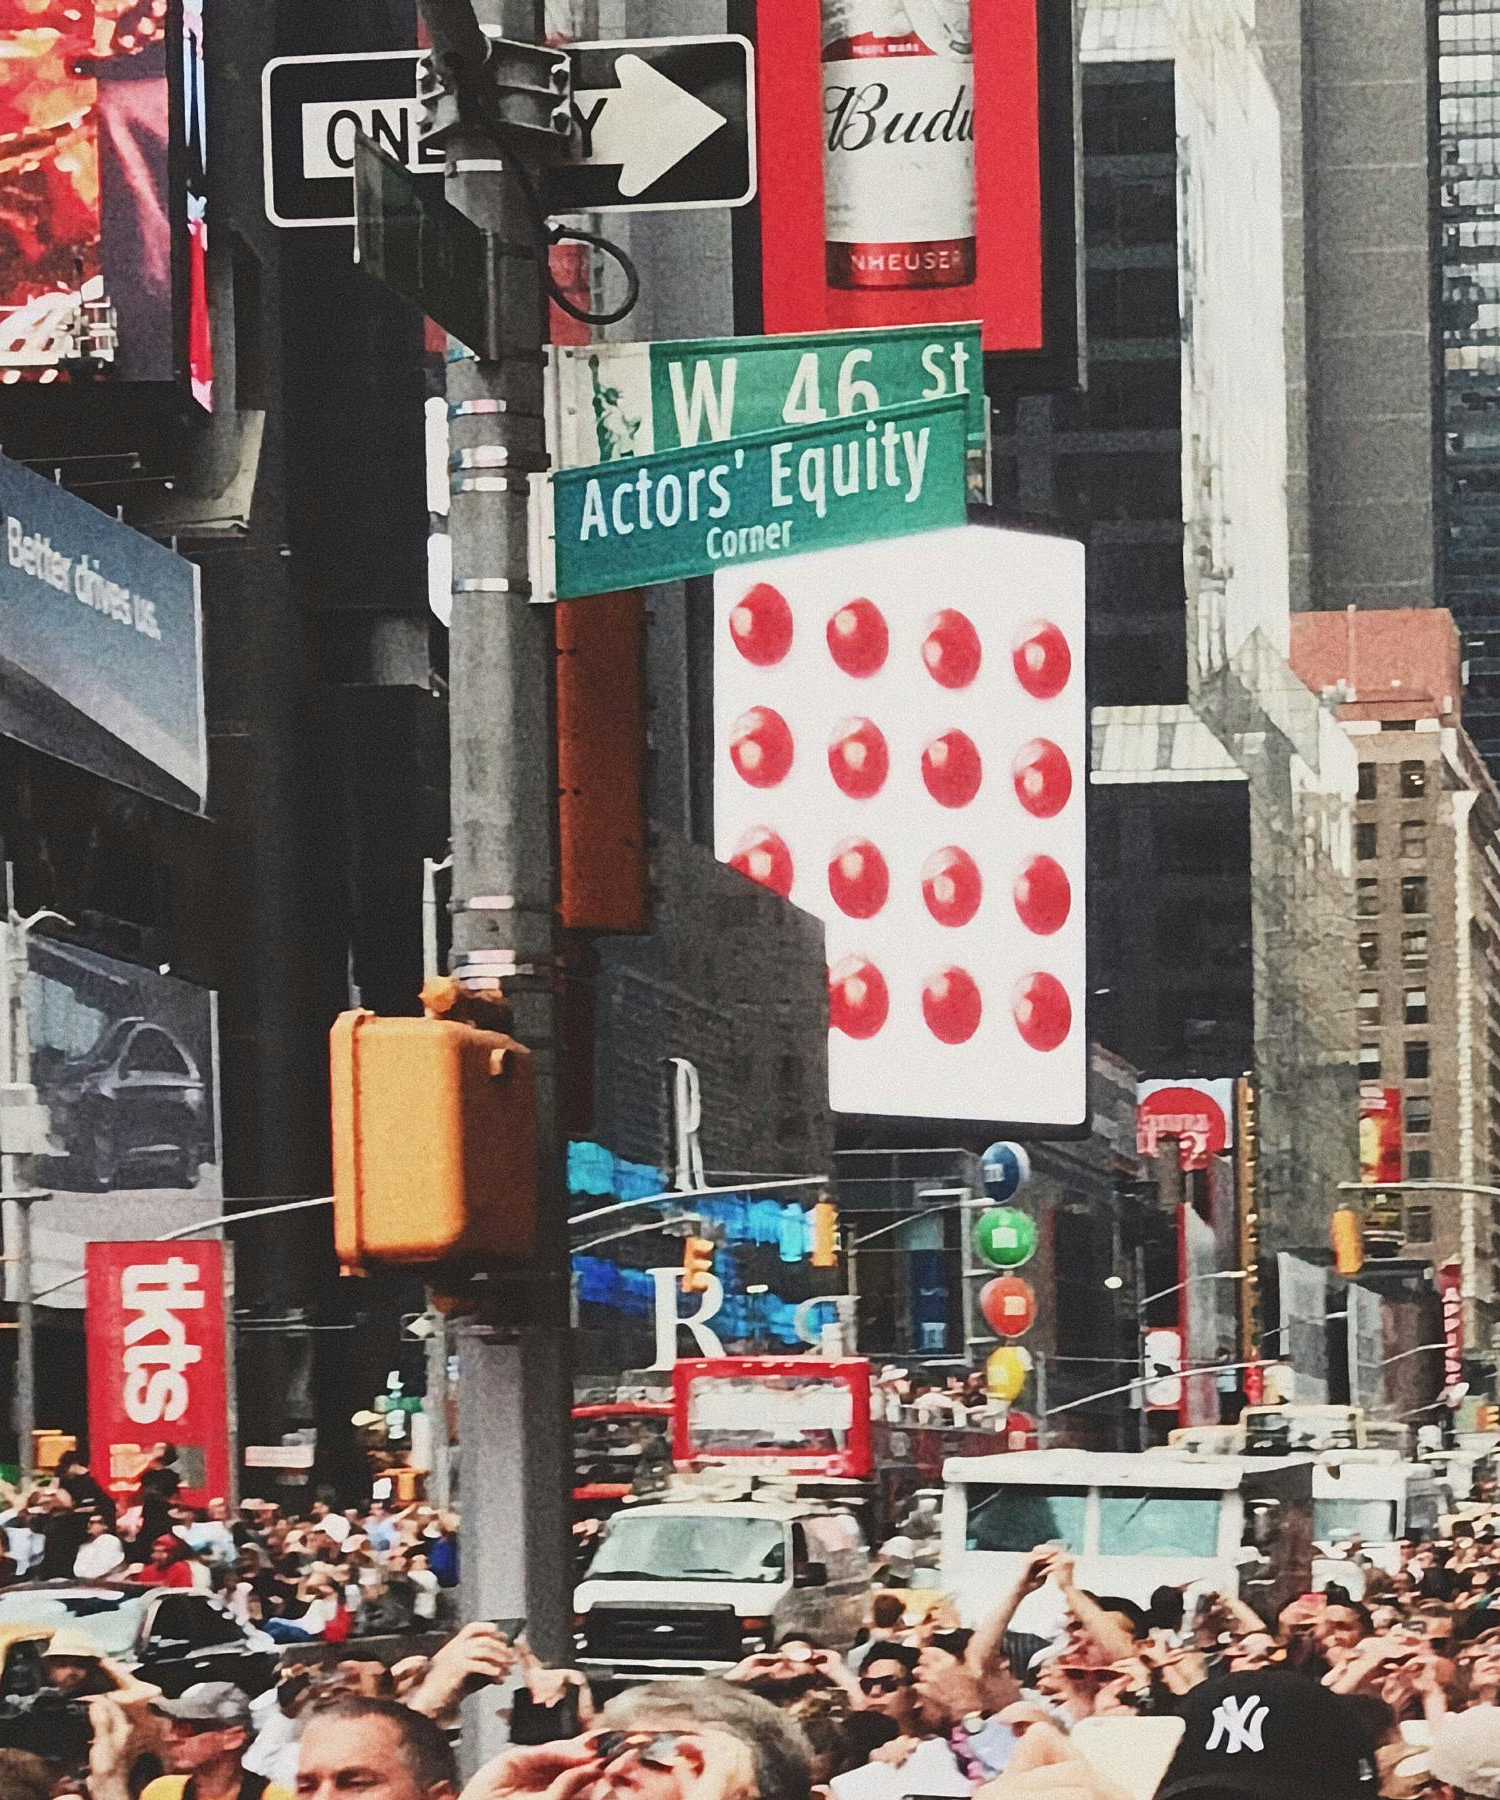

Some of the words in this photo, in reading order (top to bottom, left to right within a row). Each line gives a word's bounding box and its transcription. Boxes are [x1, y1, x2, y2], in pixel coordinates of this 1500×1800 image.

[668, 357, 738, 448] W
[782, 348, 881, 424] 46
[921, 341, 970, 399] St
[579, 448, 745, 541] Actors'
[770, 419, 931, 519] Equity
[7, 516, 72, 593] Better
[73, 554, 133, 627] drives
[706, 520, 793, 560] Corner
[120, 1256, 205, 1425] tkts
[1204, 1693, 1270, 1754] NY
